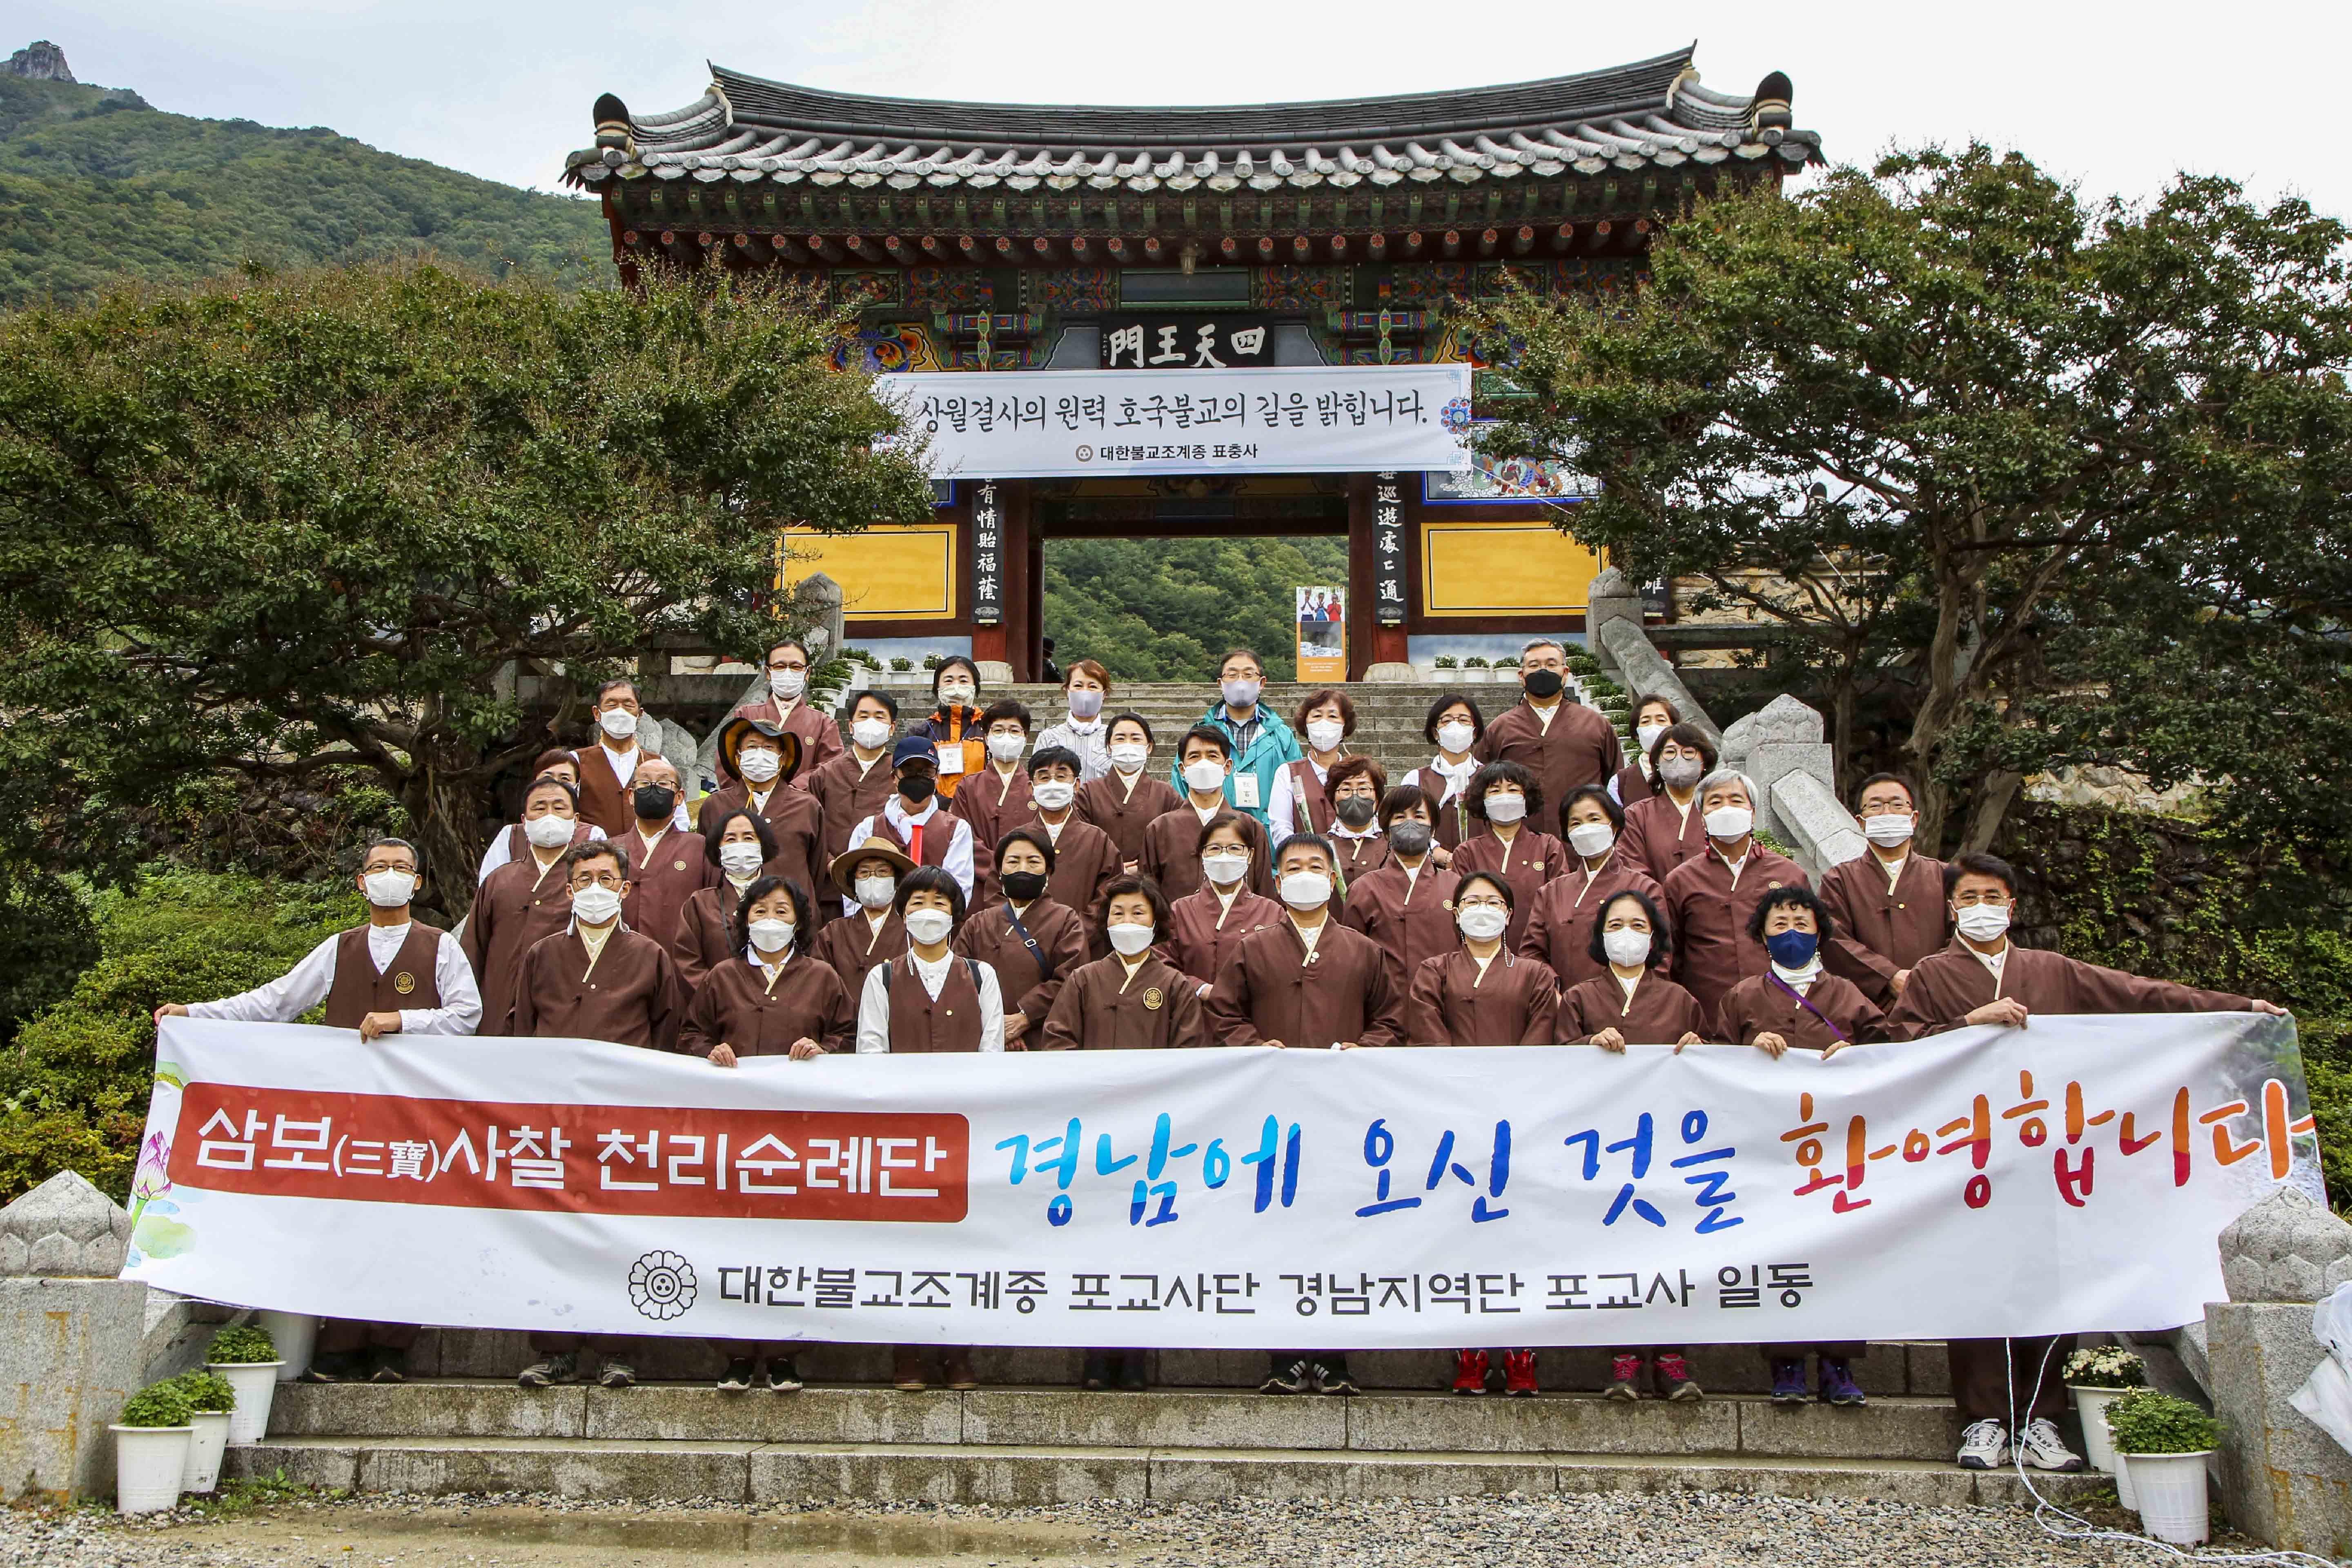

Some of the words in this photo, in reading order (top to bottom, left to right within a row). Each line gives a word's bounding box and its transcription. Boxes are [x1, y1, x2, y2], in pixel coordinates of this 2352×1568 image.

[917, 395, 1045, 433] 상월결사의
[1055, 394, 1105, 431] 원력
[1114, 392, 1245, 429] 호국불교의
[1254, 391, 1309, 428] 길을
[1316, 390, 1428, 428] 밝힙니다.
[1100, 444, 1207, 461] 대한불교조계종
[1212, 443, 1258, 459] 표충사
[597, 1128, 947, 1197] 천리순례단
[995, 1112, 1302, 1227] 경남에
[1354, 1118, 1510, 1224] 오신
[1564, 1109, 1744, 1234] 것을
[1780, 1070, 2314, 1214] 환영합니다
[717, 1266, 1048, 1314] 대한불교조계종
[1068, 1272, 1261, 1314] 포교사단
[1279, 1272, 1525, 1316] 경남지역단
[1546, 1269, 1696, 1310] 포교사
[1717, 1263, 1813, 1308] 일동
